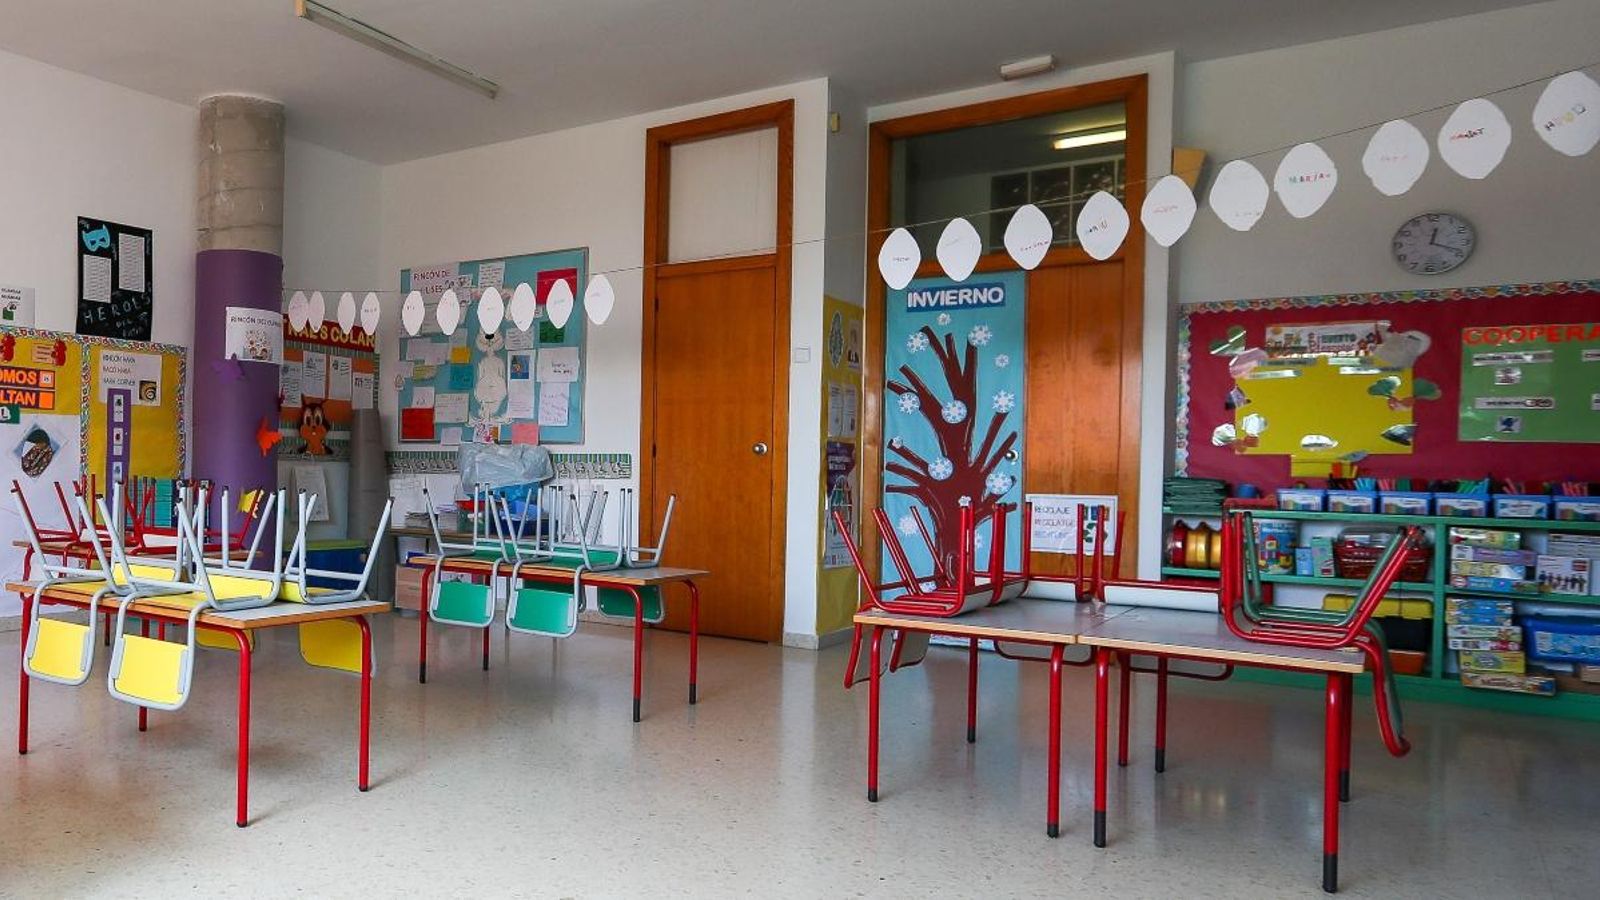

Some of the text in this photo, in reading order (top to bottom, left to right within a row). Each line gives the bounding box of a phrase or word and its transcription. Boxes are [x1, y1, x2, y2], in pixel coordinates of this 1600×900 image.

[907, 286, 1004, 308] INVIERNO
[230, 315, 255, 324] RINCÓN
[0, 369, 37, 385] MOS
[1034, 506, 1071, 515] RECICLAJE
